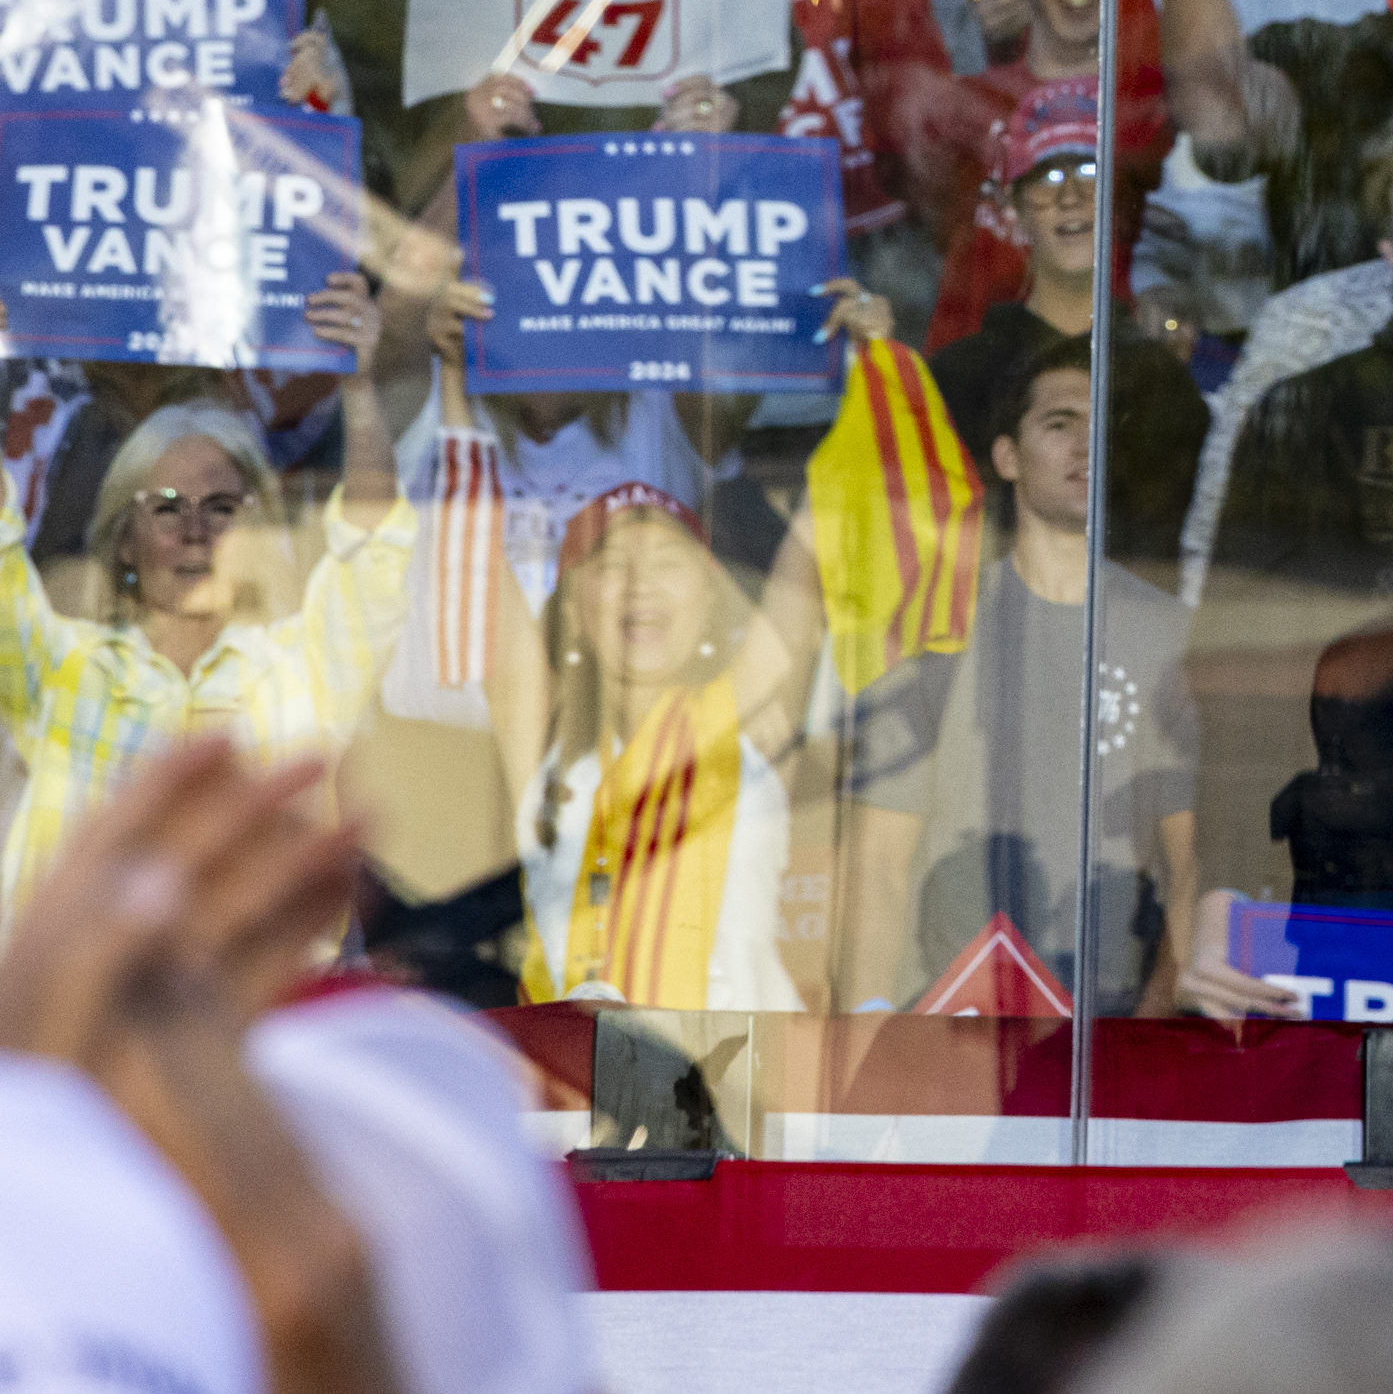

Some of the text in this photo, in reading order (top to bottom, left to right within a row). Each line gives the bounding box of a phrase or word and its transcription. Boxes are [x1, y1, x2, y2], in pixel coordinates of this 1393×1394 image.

[0, 40, 237, 95] VANCE
[42, 225, 290, 282] VANE
[498, 197, 808, 257] TRUMP
[533, 256, 780, 306] VANCE
[627, 360, 692, 382] 2024
